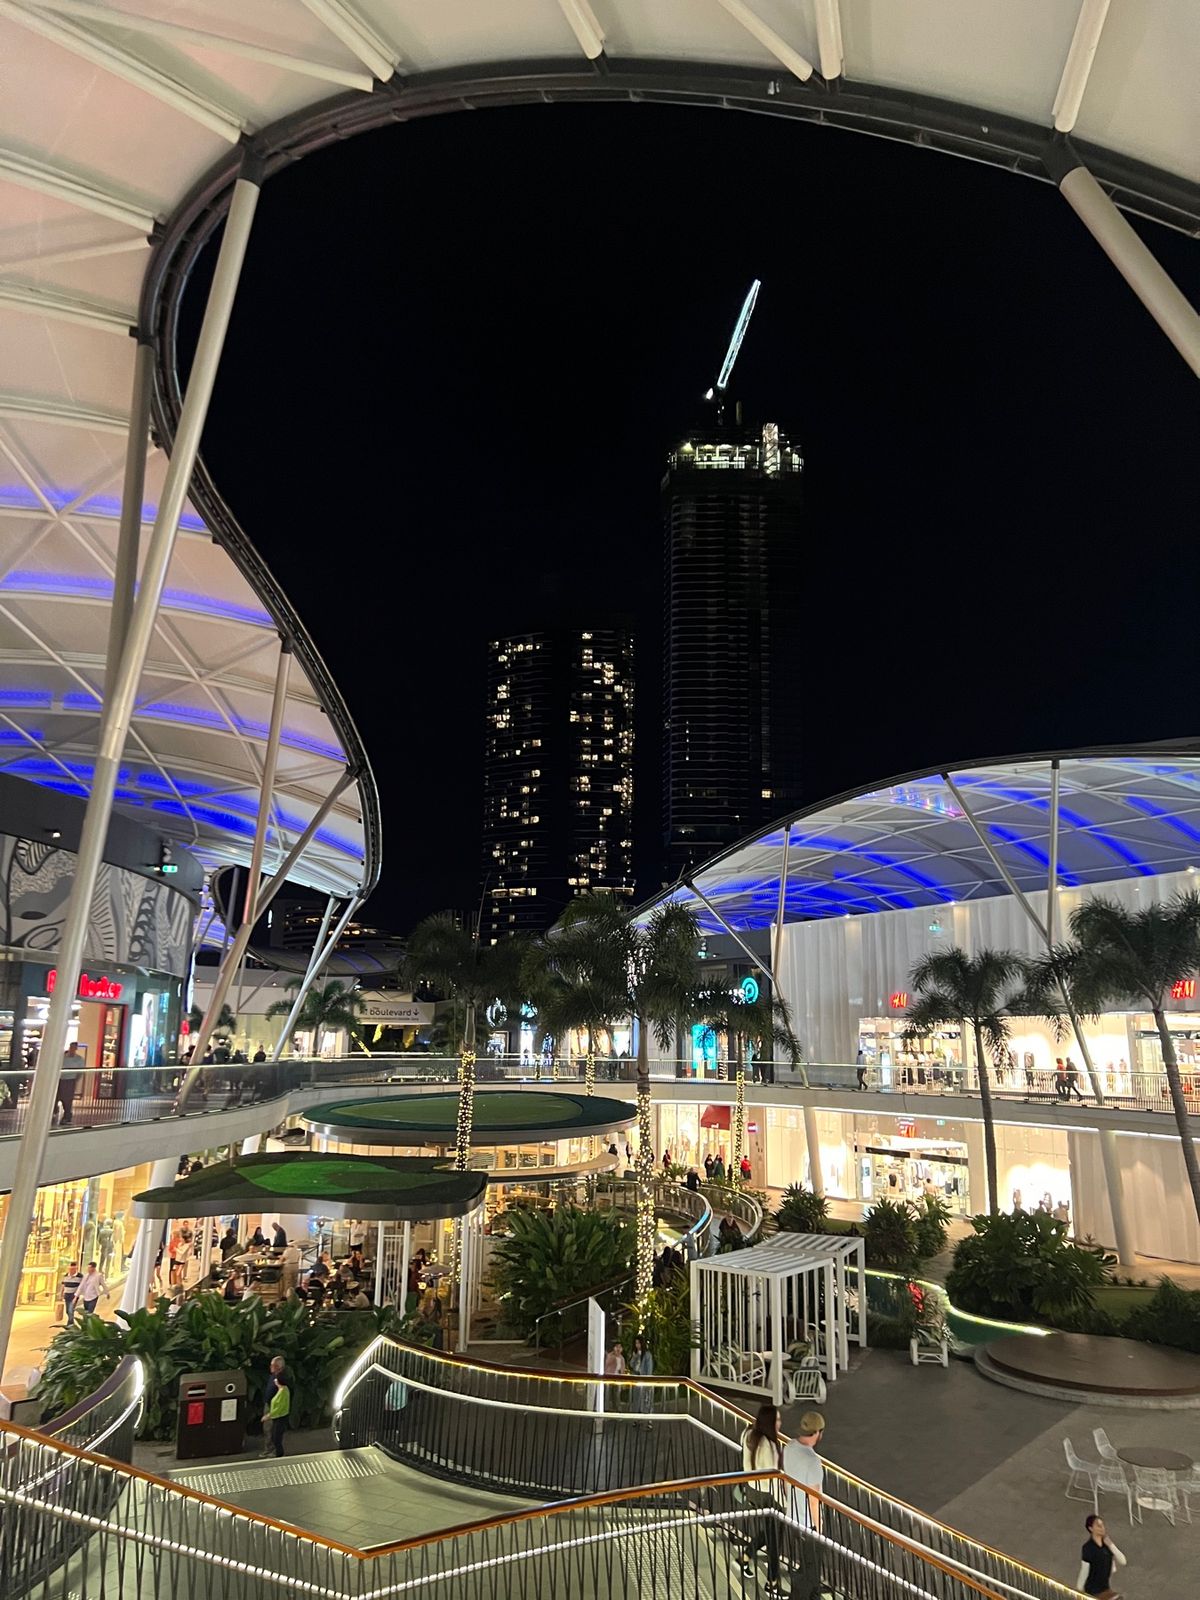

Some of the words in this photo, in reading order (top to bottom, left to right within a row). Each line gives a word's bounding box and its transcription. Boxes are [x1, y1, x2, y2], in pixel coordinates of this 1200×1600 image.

[1171, 979, 1196, 1000] H&M
[891, 992, 908, 1008] H&M
[369, 1008, 412, 1016] boulevard
